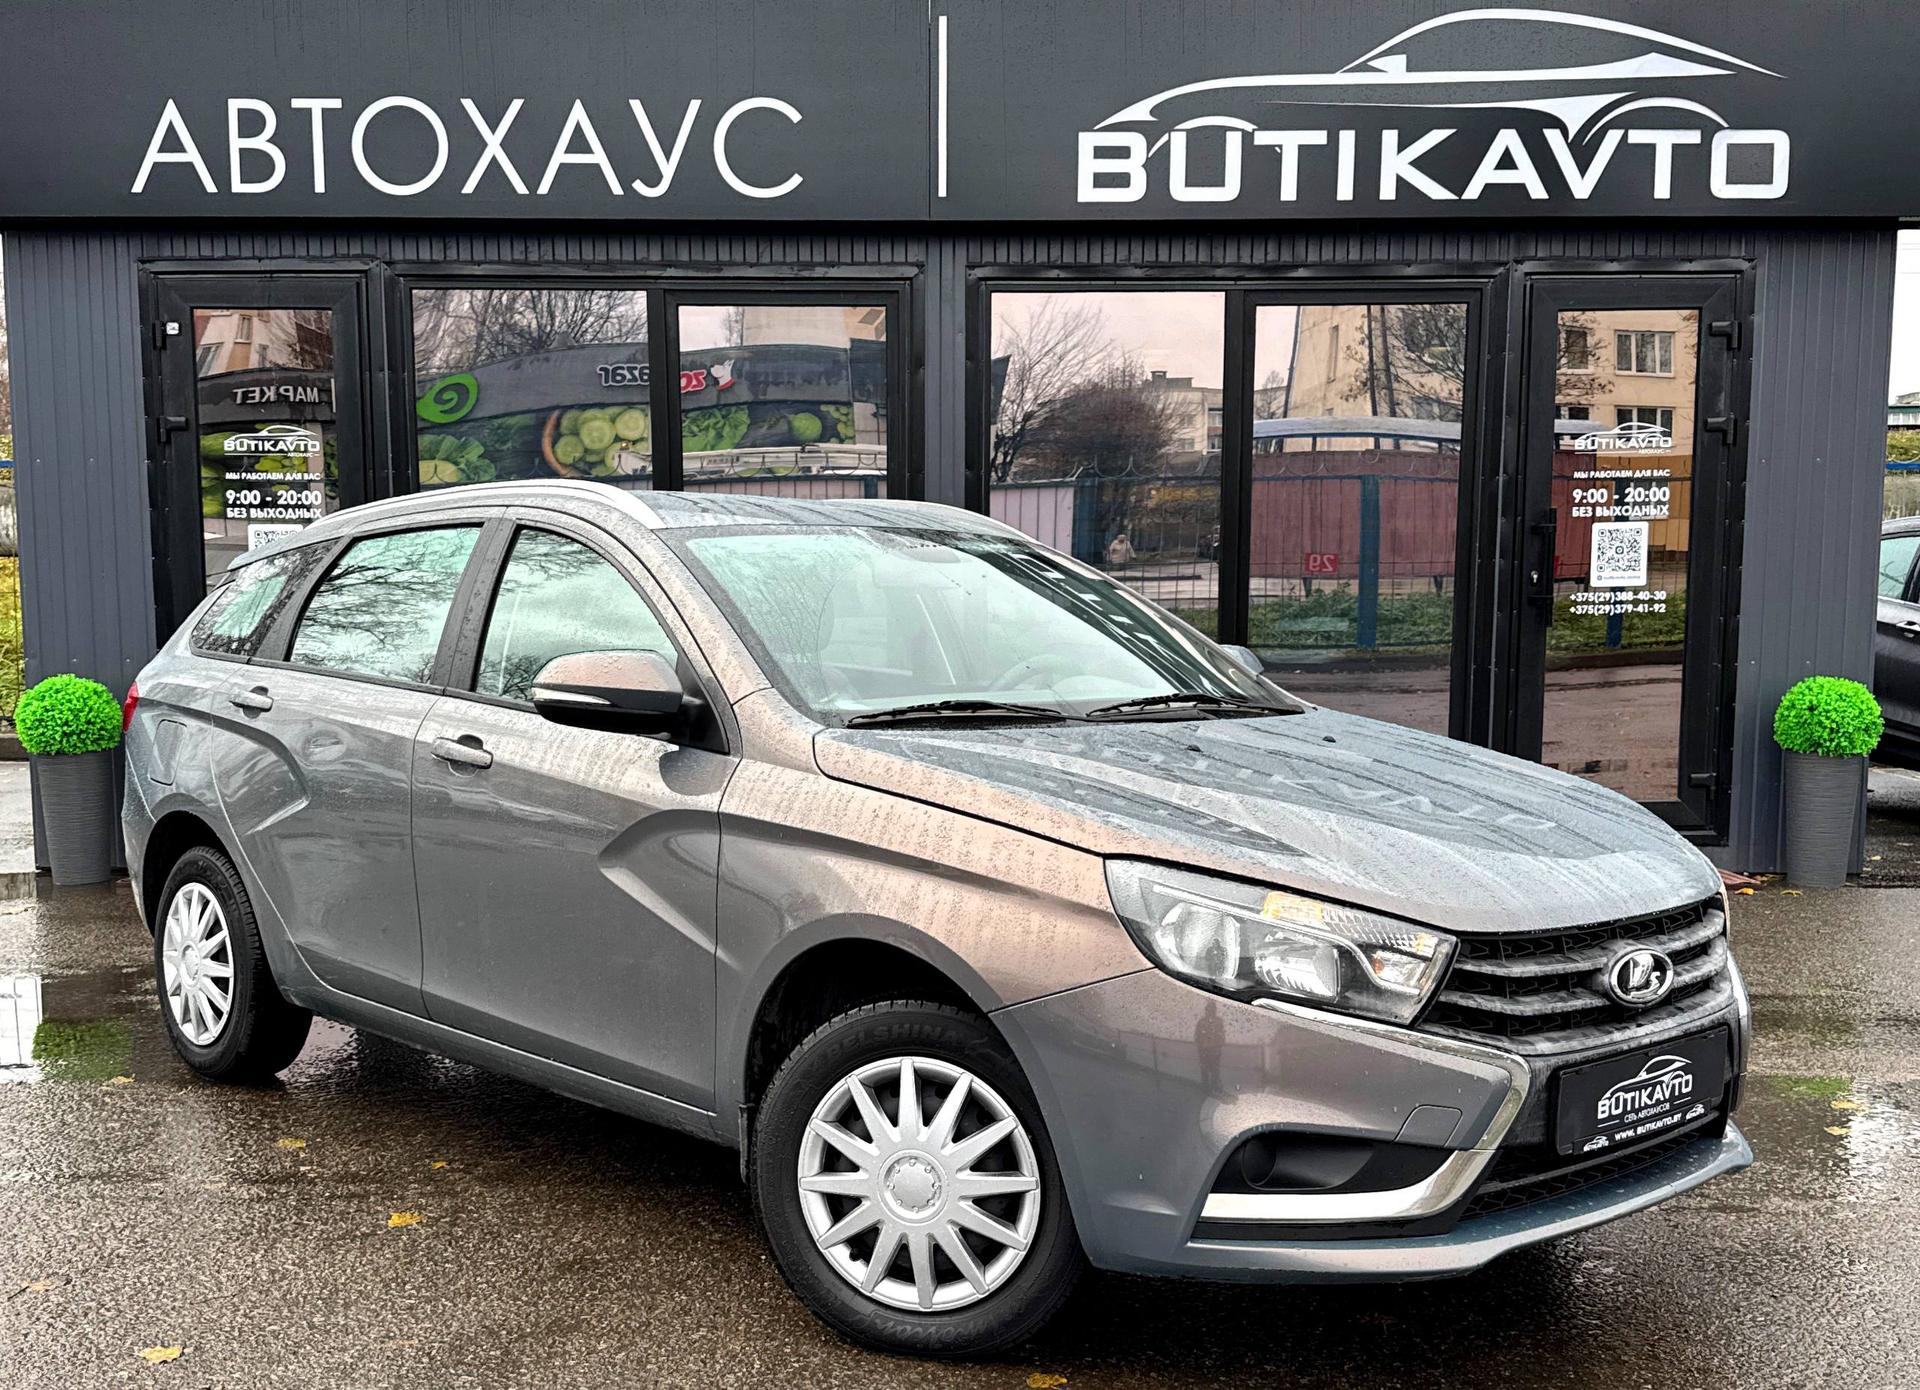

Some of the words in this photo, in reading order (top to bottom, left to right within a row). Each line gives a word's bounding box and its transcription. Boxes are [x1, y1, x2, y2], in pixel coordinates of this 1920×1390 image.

[131, 96, 804, 198] АВТОХАУС
[1078, 129, 1790, 203] BUTIKAVTO
[224, 440, 320, 451] BUTIKAVTO
[1574, 437, 1672, 450] BUTIKAVTO
[225, 472, 240, 480] МЫ
[241, 472, 284, 480] РАБОТАЕМ
[285, 472, 302, 481] ДЛЯ
[303, 472, 321, 480] ВАС
[1573, 471, 1588, 479] МЫ
[1589, 470, 1633, 479] РАБОТАЕМ
[1634, 470, 1651, 478] ДЛЯ
[1653, 469, 1671, 477] ВАС
[225, 490, 261, 505] 9:00
[277, 490, 322, 505] 20:00
[1572, 488, 1608, 504] 9:00
[1624, 487, 1670, 503] 20:00
[226, 508, 247, 518] БЕЗ
[250, 508, 322, 519] ВЫХОДНЫХ
[1572, 506, 1593, 518] БЕЗ
[1595, 504, 1670, 517] ВЫХОДНЫХ
[1569, 591, 1667, 602] +375(29)388-40-30
[1569, 604, 1667, 615] +375(29)379-41-92
[1597, 1074, 1693, 1119] BUTIKAVTO
